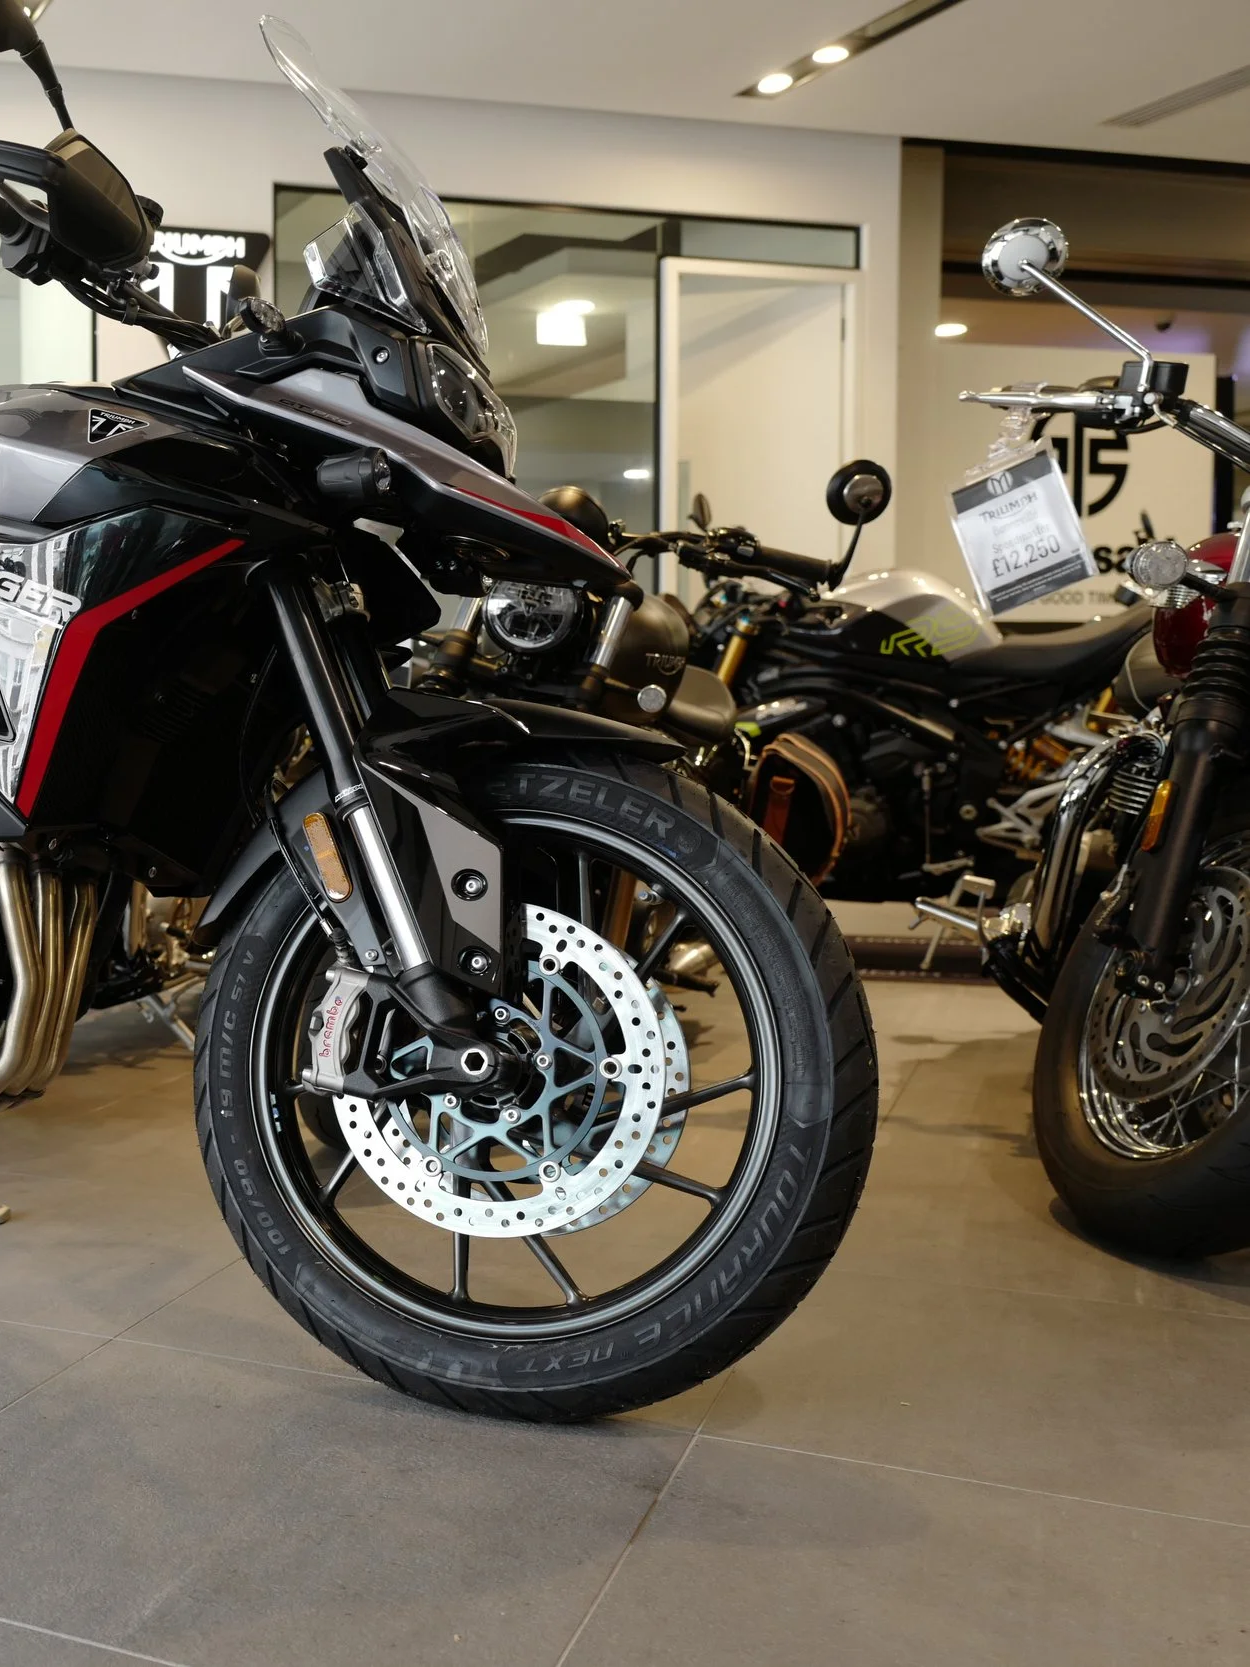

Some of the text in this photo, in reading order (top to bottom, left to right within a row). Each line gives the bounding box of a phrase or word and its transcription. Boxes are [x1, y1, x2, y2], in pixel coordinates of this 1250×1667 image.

[151, 231, 246, 262] RIUMPH
[100, 411, 136, 425] TRIUMPH
[979, 490, 1039, 523] TRIUMPH
[992, 534, 1061, 578] £12,250
[319, 997, 343, 1058] brembo
[233, 1158, 292, 1255] 100/90
[634, 1143, 814, 1347] TOURANCE
